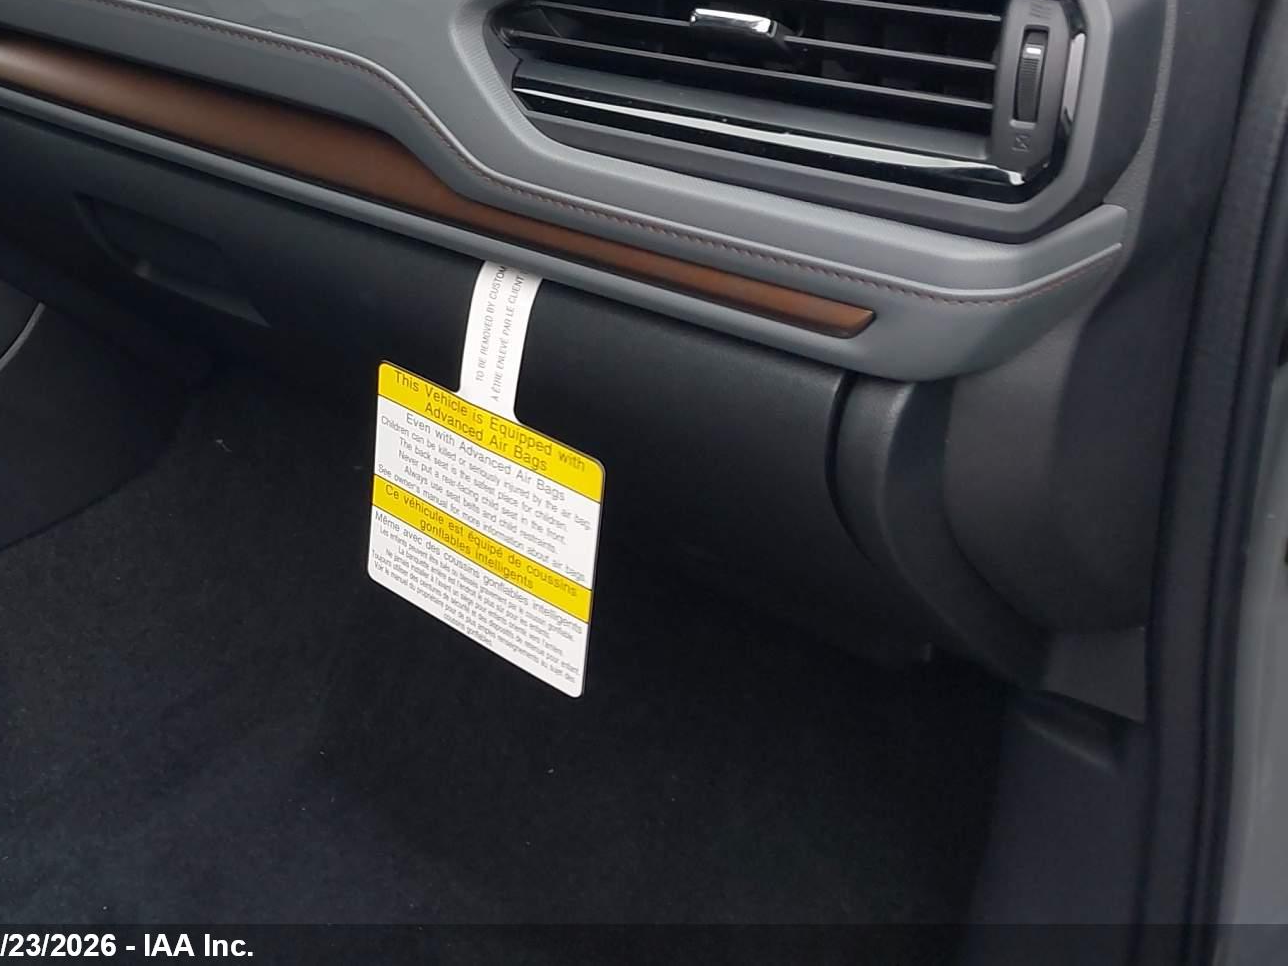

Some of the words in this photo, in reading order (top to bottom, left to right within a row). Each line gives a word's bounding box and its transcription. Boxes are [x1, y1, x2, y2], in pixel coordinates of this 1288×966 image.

[487, 302, 496, 314] BY
[507, 275, 525, 304] CLIENT
[502, 319, 513, 337] PAR
[505, 305, 515, 318] LE
[480, 315, 493, 355] REMOVED
[475, 372, 485, 381] TO
[478, 359, 487, 368] BE
[394, 369, 420, 393] This
[424, 384, 468, 417] Vehicle
[472, 407, 484, 424] is
[488, 413, 552, 460] Equipped
[557, 447, 585, 473] with
[423, 399, 483, 442] Advanced
[488, 432, 507, 453] Air
[513, 443, 548, 476] Bags
[405, 411, 431, 435] Even
[434, 426, 455, 447] with
[458, 438, 511, 476] Advanced
[515, 467, 531, 485] Air
[535, 477, 566, 506] Bags
[374, 510, 400, 532] Même
[402, 527, 423, 546] avec
[425, 539, 440, 556] des
[442, 550, 480, 579] coussins
[385, 483, 399, 500] Ce
[402, 492, 444, 526] véhicule
[447, 519, 463, 537] est
[466, 529, 503, 561] équipé
[507, 551, 521, 568] de
[525, 560, 577, 598] coussins
[419, 517, 471, 556] gonflables
[474, 548, 533, 593] intelligents
